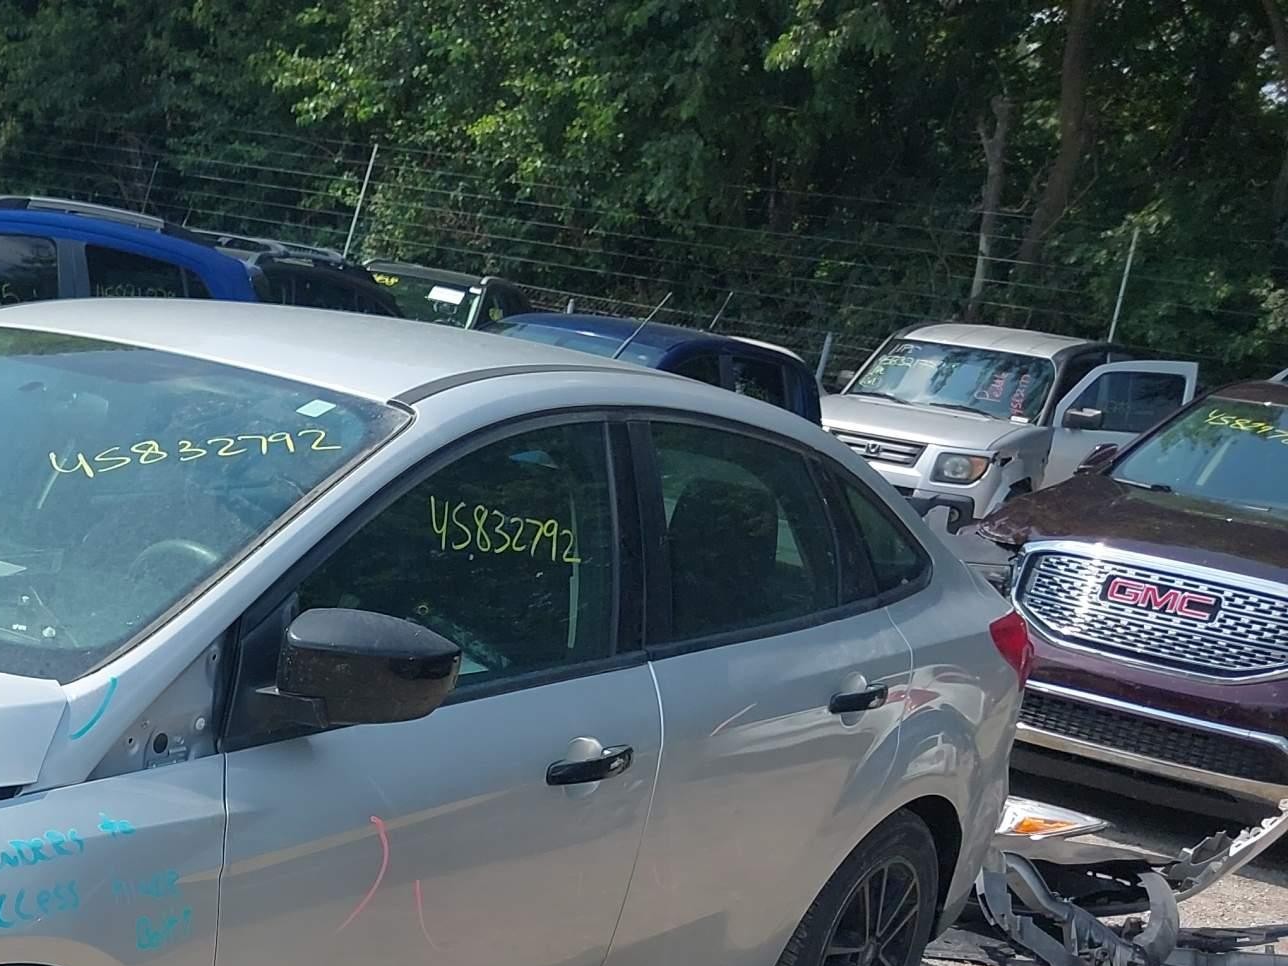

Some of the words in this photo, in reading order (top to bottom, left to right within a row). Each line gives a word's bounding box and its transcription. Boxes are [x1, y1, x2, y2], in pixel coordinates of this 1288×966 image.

[49, 429, 343, 478] 45832792
[430, 495, 582, 563] 45832792
[1107, 577, 1216, 620] GMC
